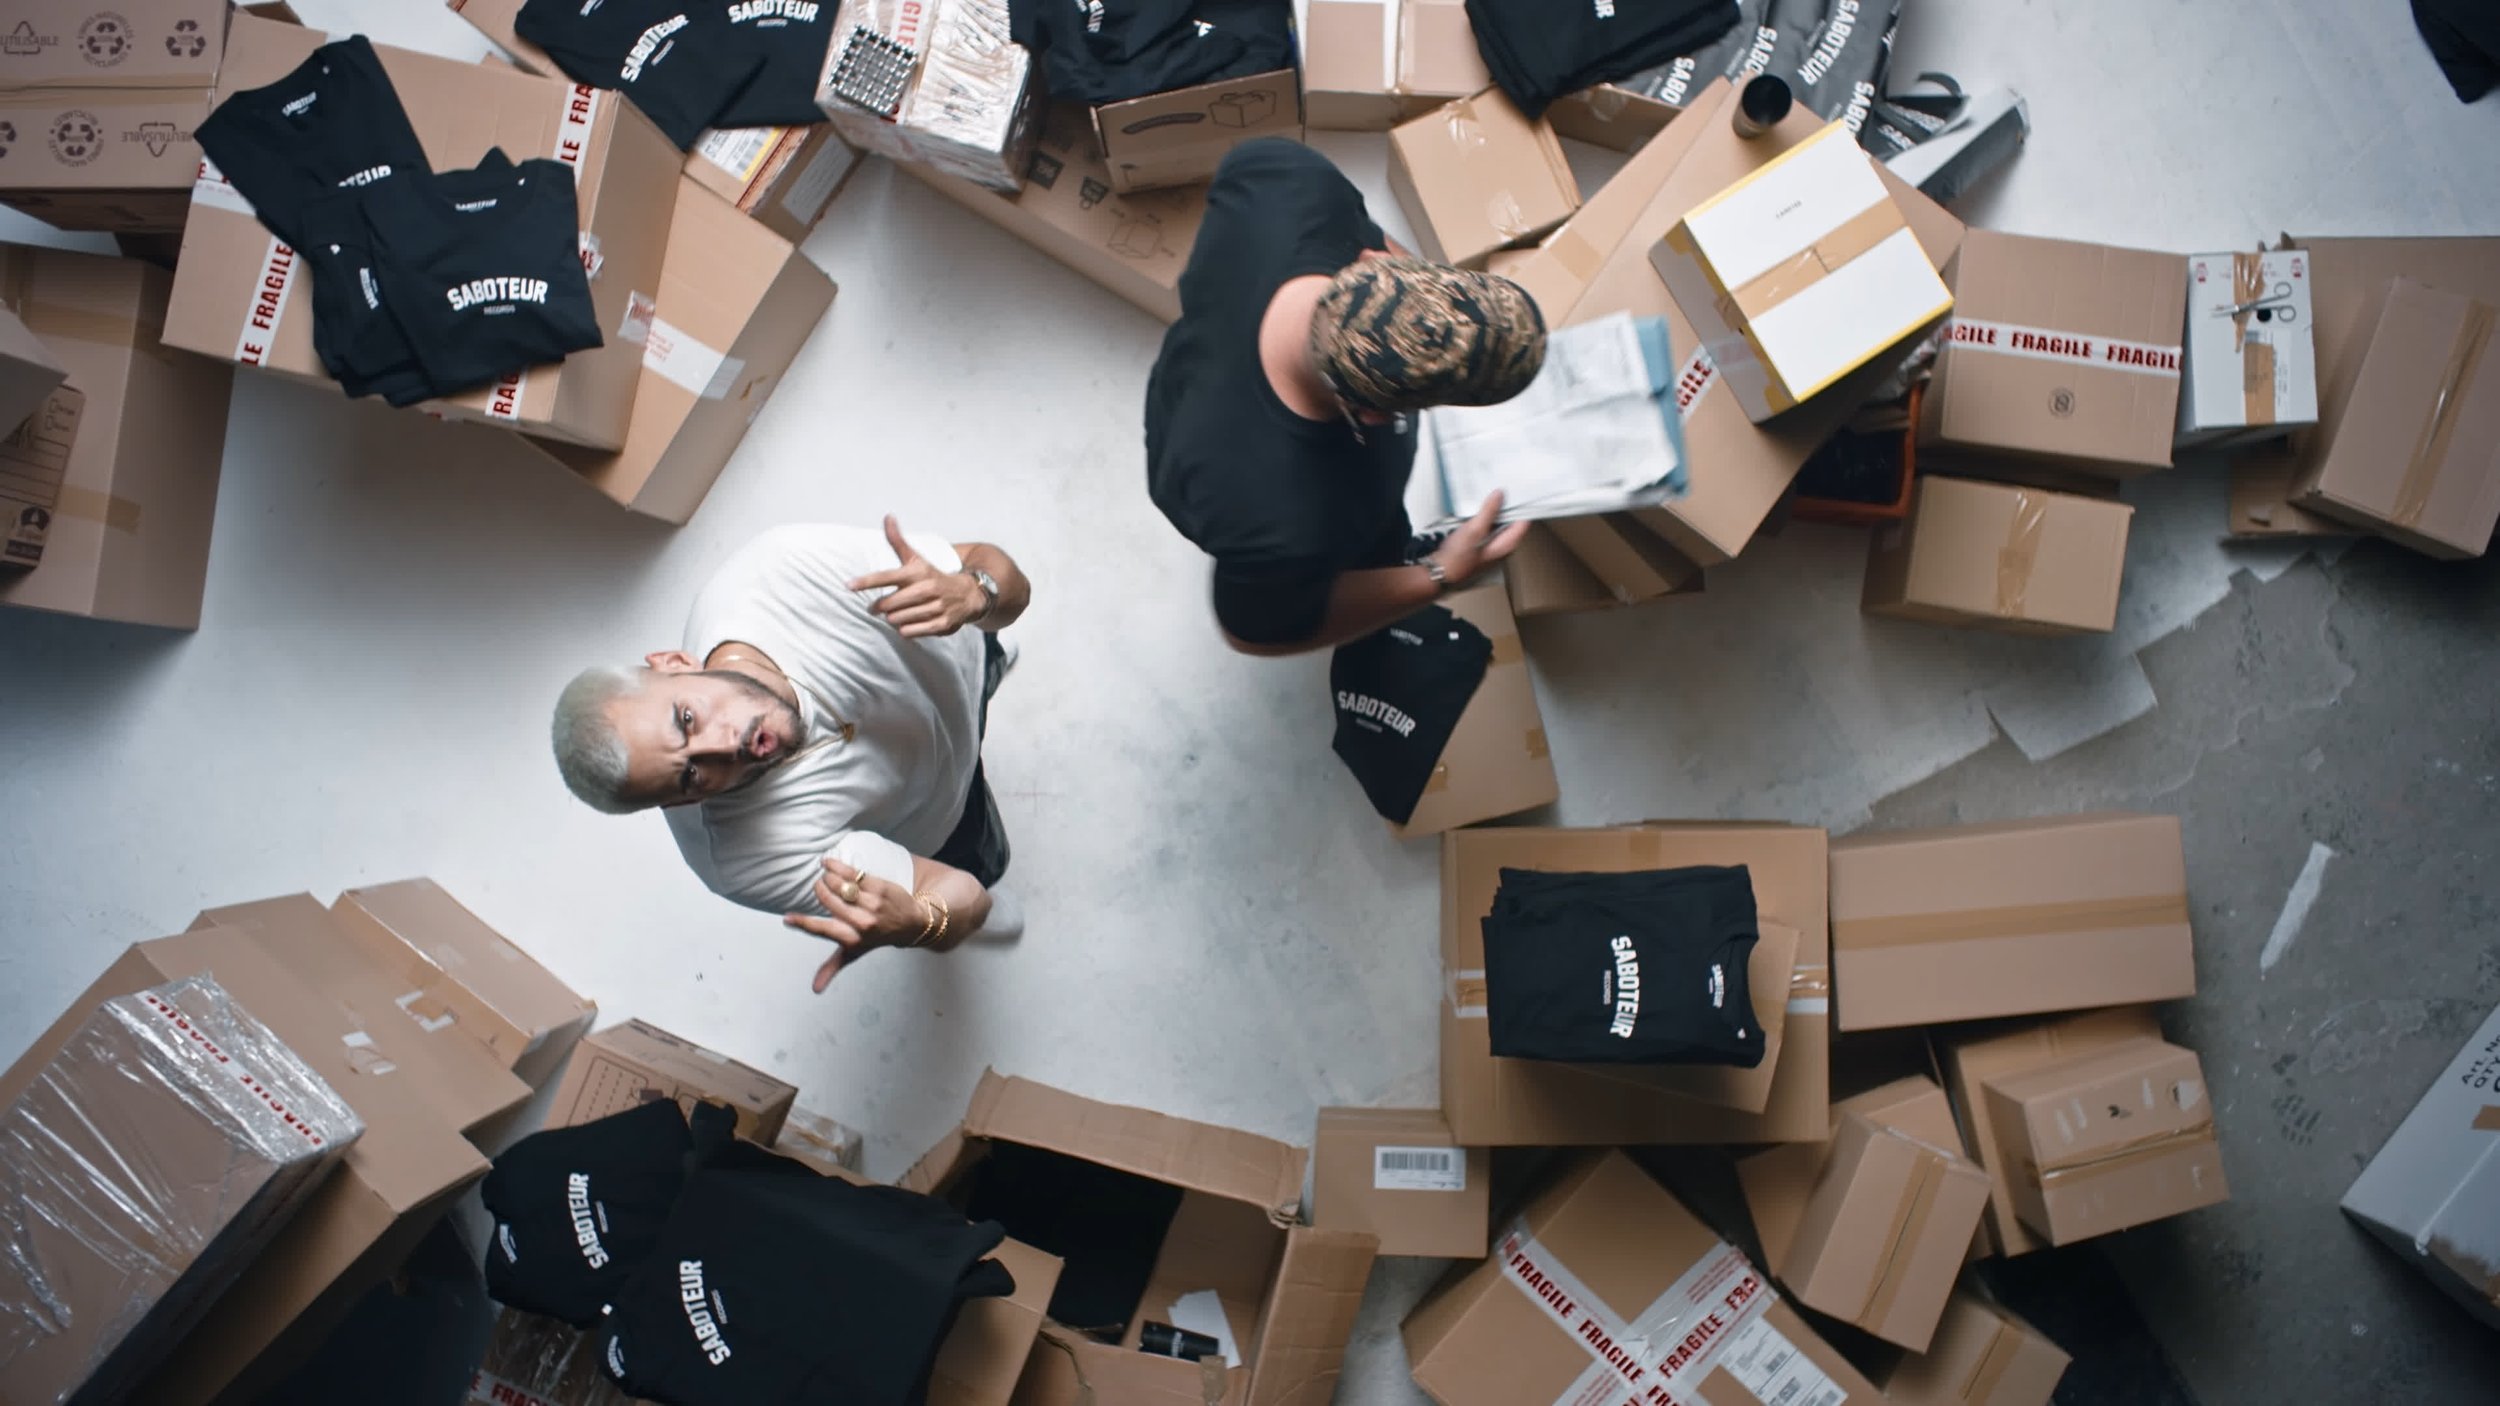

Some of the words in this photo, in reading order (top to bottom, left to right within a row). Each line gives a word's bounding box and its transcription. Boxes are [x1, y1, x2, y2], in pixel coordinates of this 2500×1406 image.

[621, 14, 689, 82] SABOTEUR
[727, 0, 819, 24] SABOTEUR
[1798, 0, 1860, 86] SABOTEUR
[252, 243, 295, 330] FRAGILE
[447, 277, 548, 311] SABOTEUR
[2011, 332, 2093, 359] FRAGILE
[1338, 690, 1416, 738] SABOTEUR
[1609, 935, 1640, 1039] SABOTEUR
[568, 1172, 609, 1269] SABOTEUR
[679, 1260, 731, 1365] SABOTEUR
[1510, 1253, 1577, 1319] FRAGILE
[1578, 1318, 1646, 1384] FRAGILE
[1658, 1312, 1724, 1380] FRAGILE
